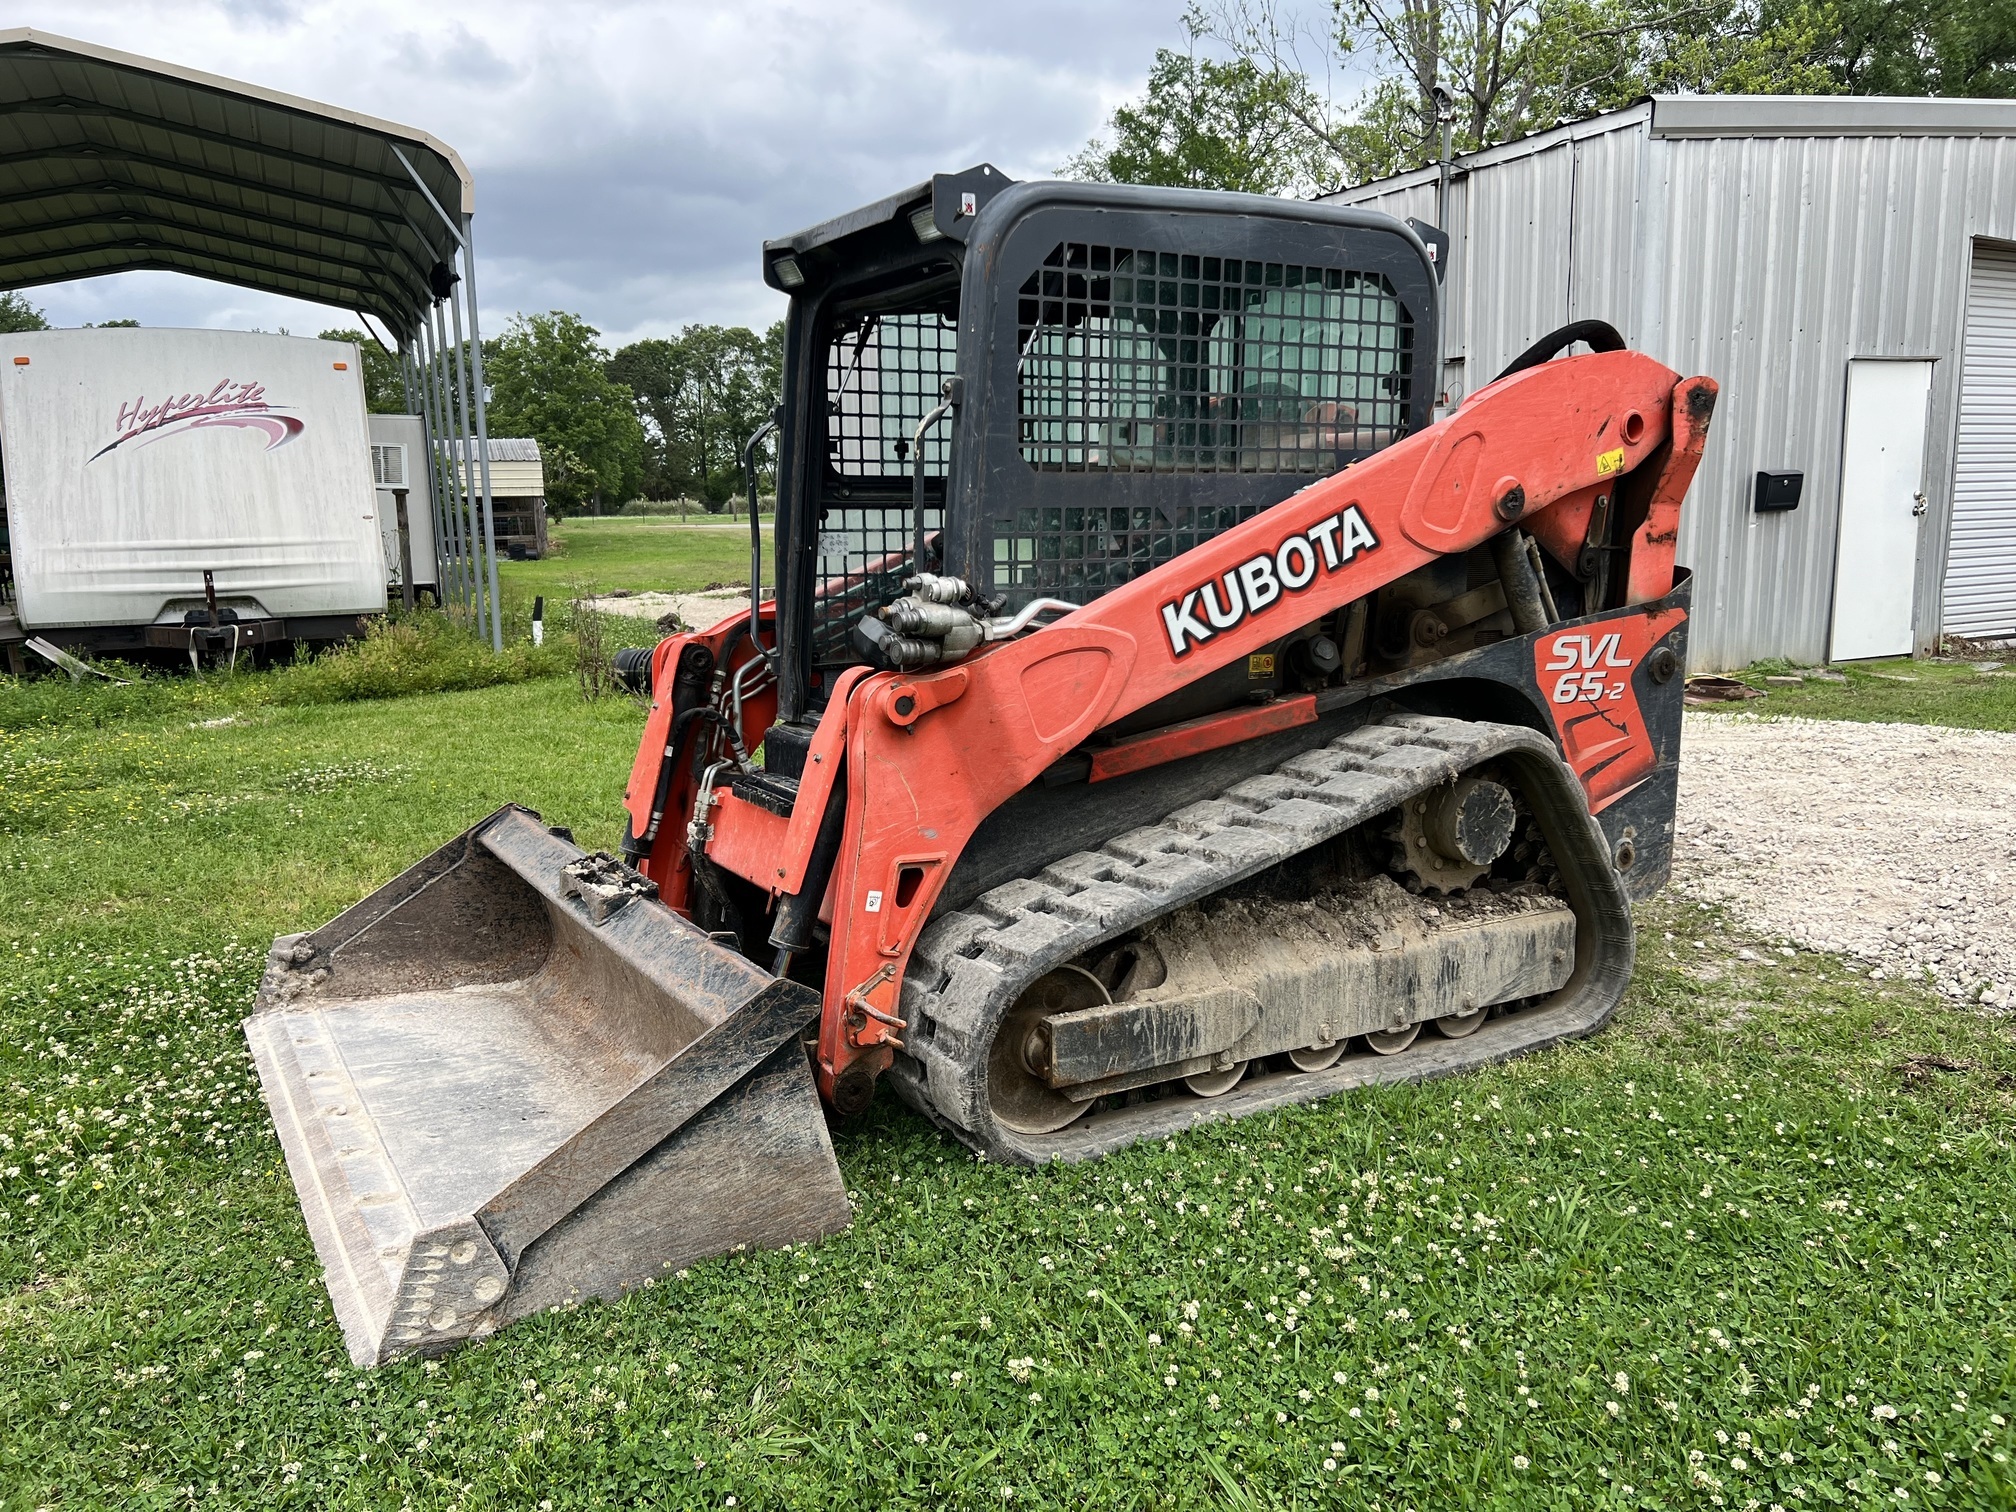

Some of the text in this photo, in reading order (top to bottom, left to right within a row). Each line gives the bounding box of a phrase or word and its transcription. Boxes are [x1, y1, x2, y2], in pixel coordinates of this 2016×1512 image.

[116, 378, 266, 435] Hyperlite
[1161, 505, 1377, 656] KUBOTA
[1545, 633, 1632, 671] SVL
[1552, 671, 1626, 704] 65-2
